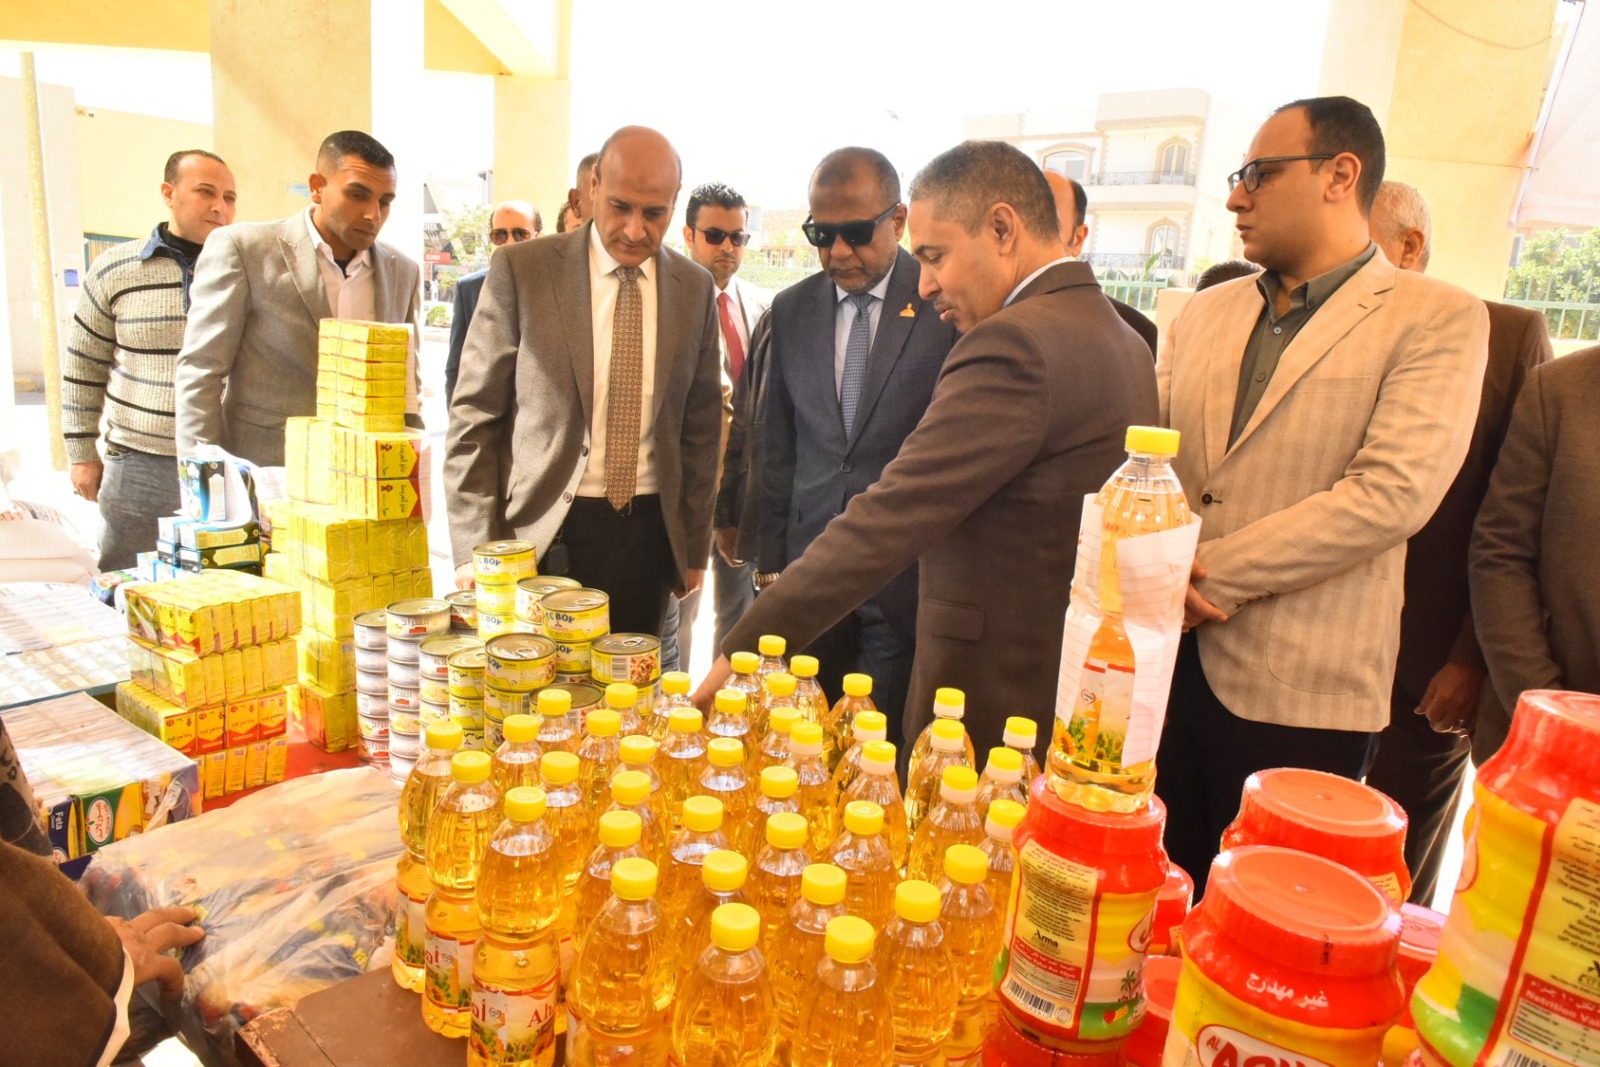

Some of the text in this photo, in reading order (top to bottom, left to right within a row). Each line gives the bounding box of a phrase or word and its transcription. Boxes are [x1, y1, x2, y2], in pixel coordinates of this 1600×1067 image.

[55, 812, 64, 830] Feta
[1035, 929, 1059, 947] Arma
[1246, 972, 1329, 1010] غير مهدرج
[1525, 990, 1577, 1018] Nutrition
[1206, 1035, 1221, 1051] AL
